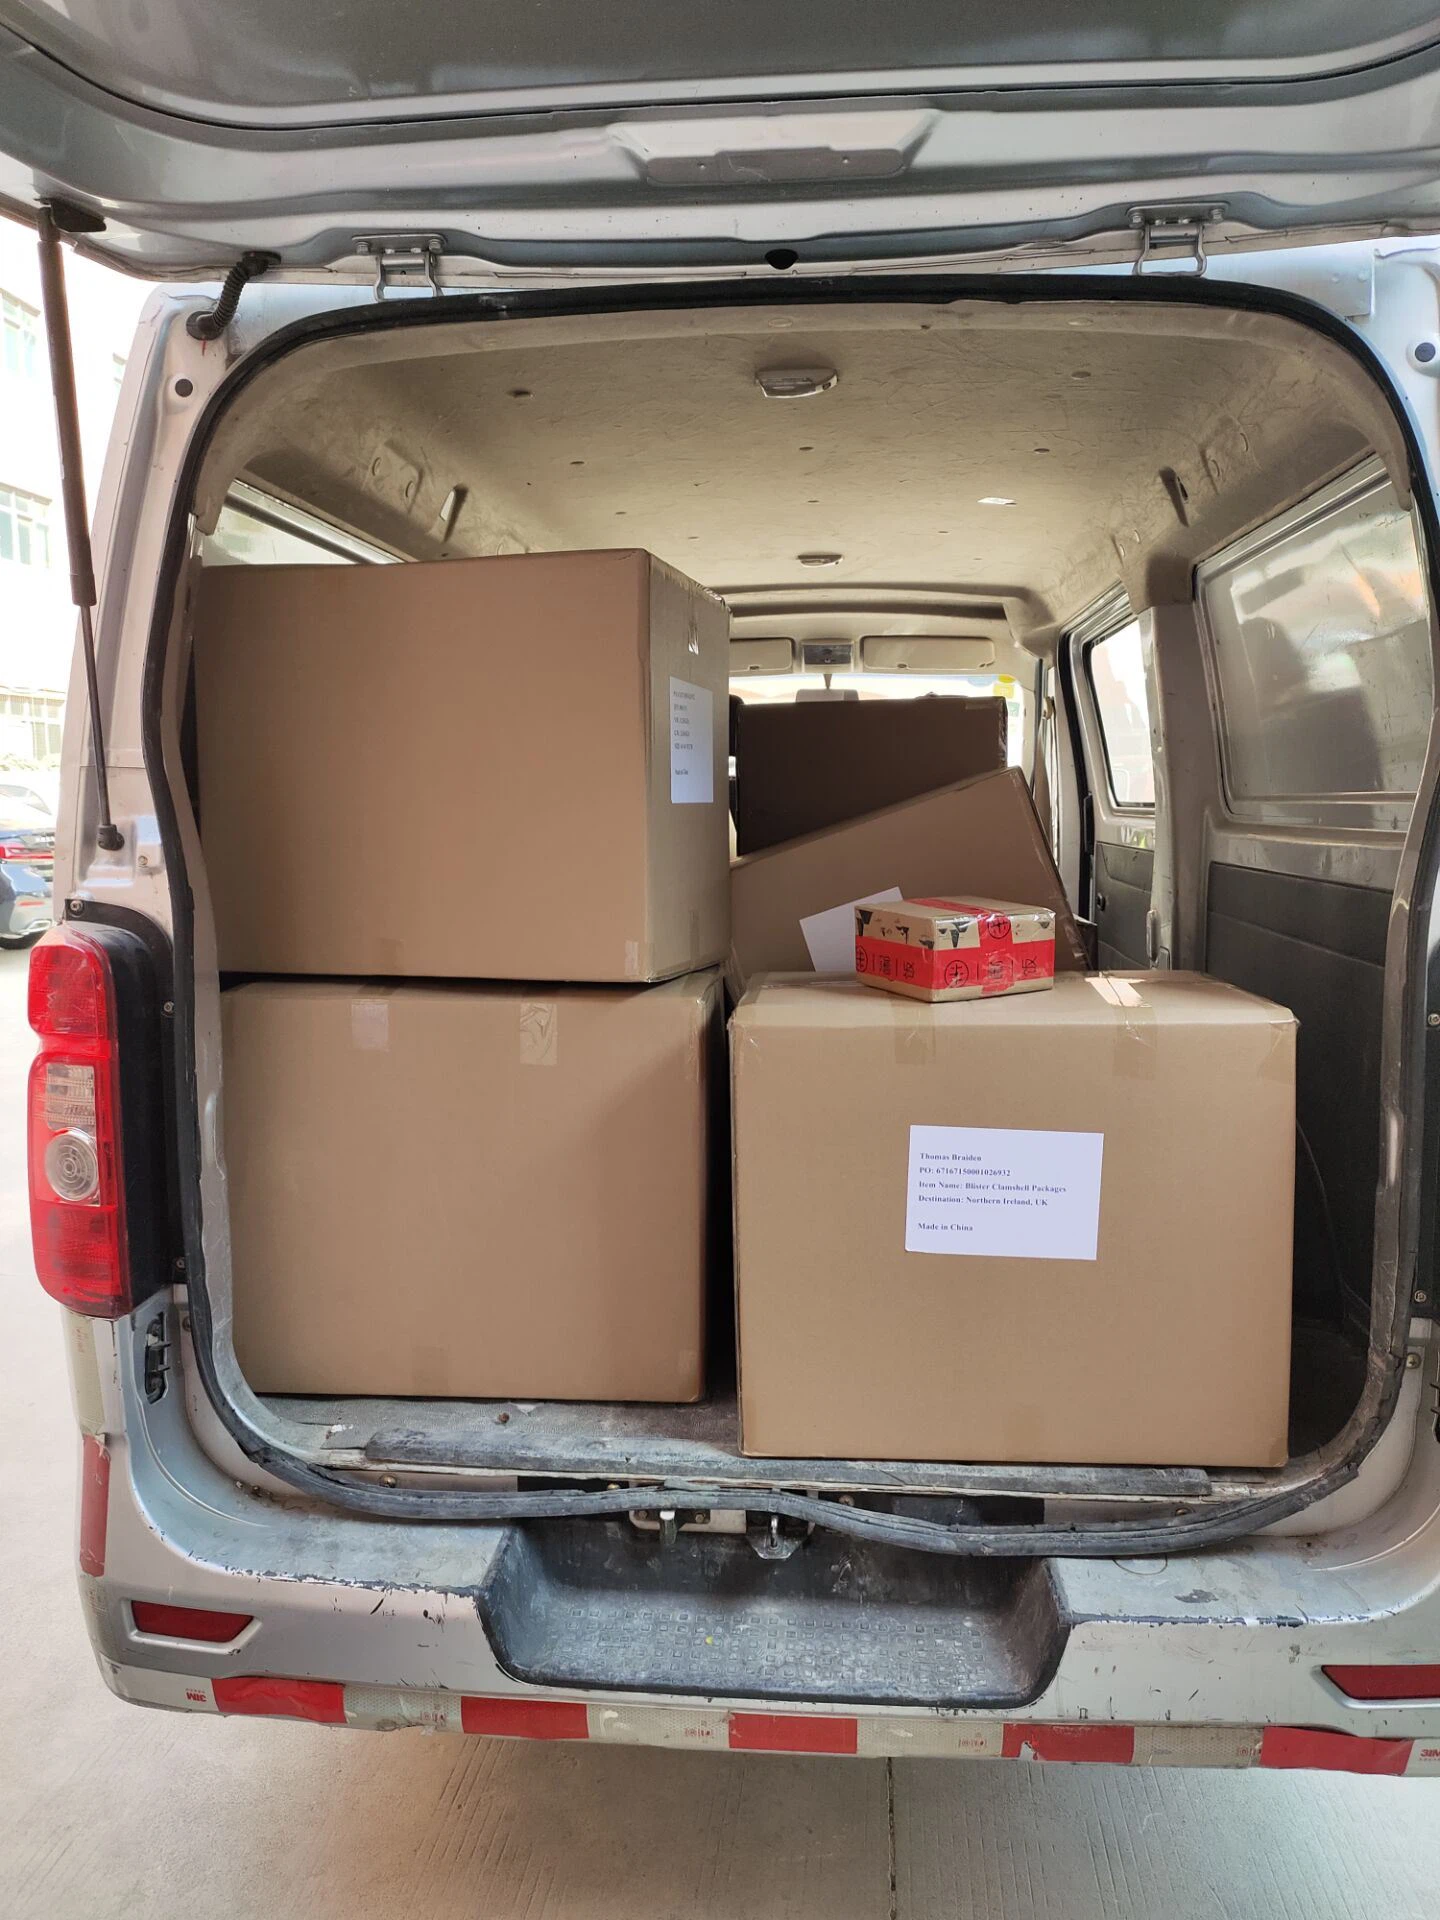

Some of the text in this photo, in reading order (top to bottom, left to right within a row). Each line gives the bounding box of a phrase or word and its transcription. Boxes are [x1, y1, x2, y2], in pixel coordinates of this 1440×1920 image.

[920, 1153, 982, 1162] Thomas Braiden
[919, 1181, 1067, 1194] Item Name: Blister Clamshell Packages
[918, 1195, 1048, 1207] Destination: Northern Ireland, UK
[918, 1222, 973, 1232] Made in China
